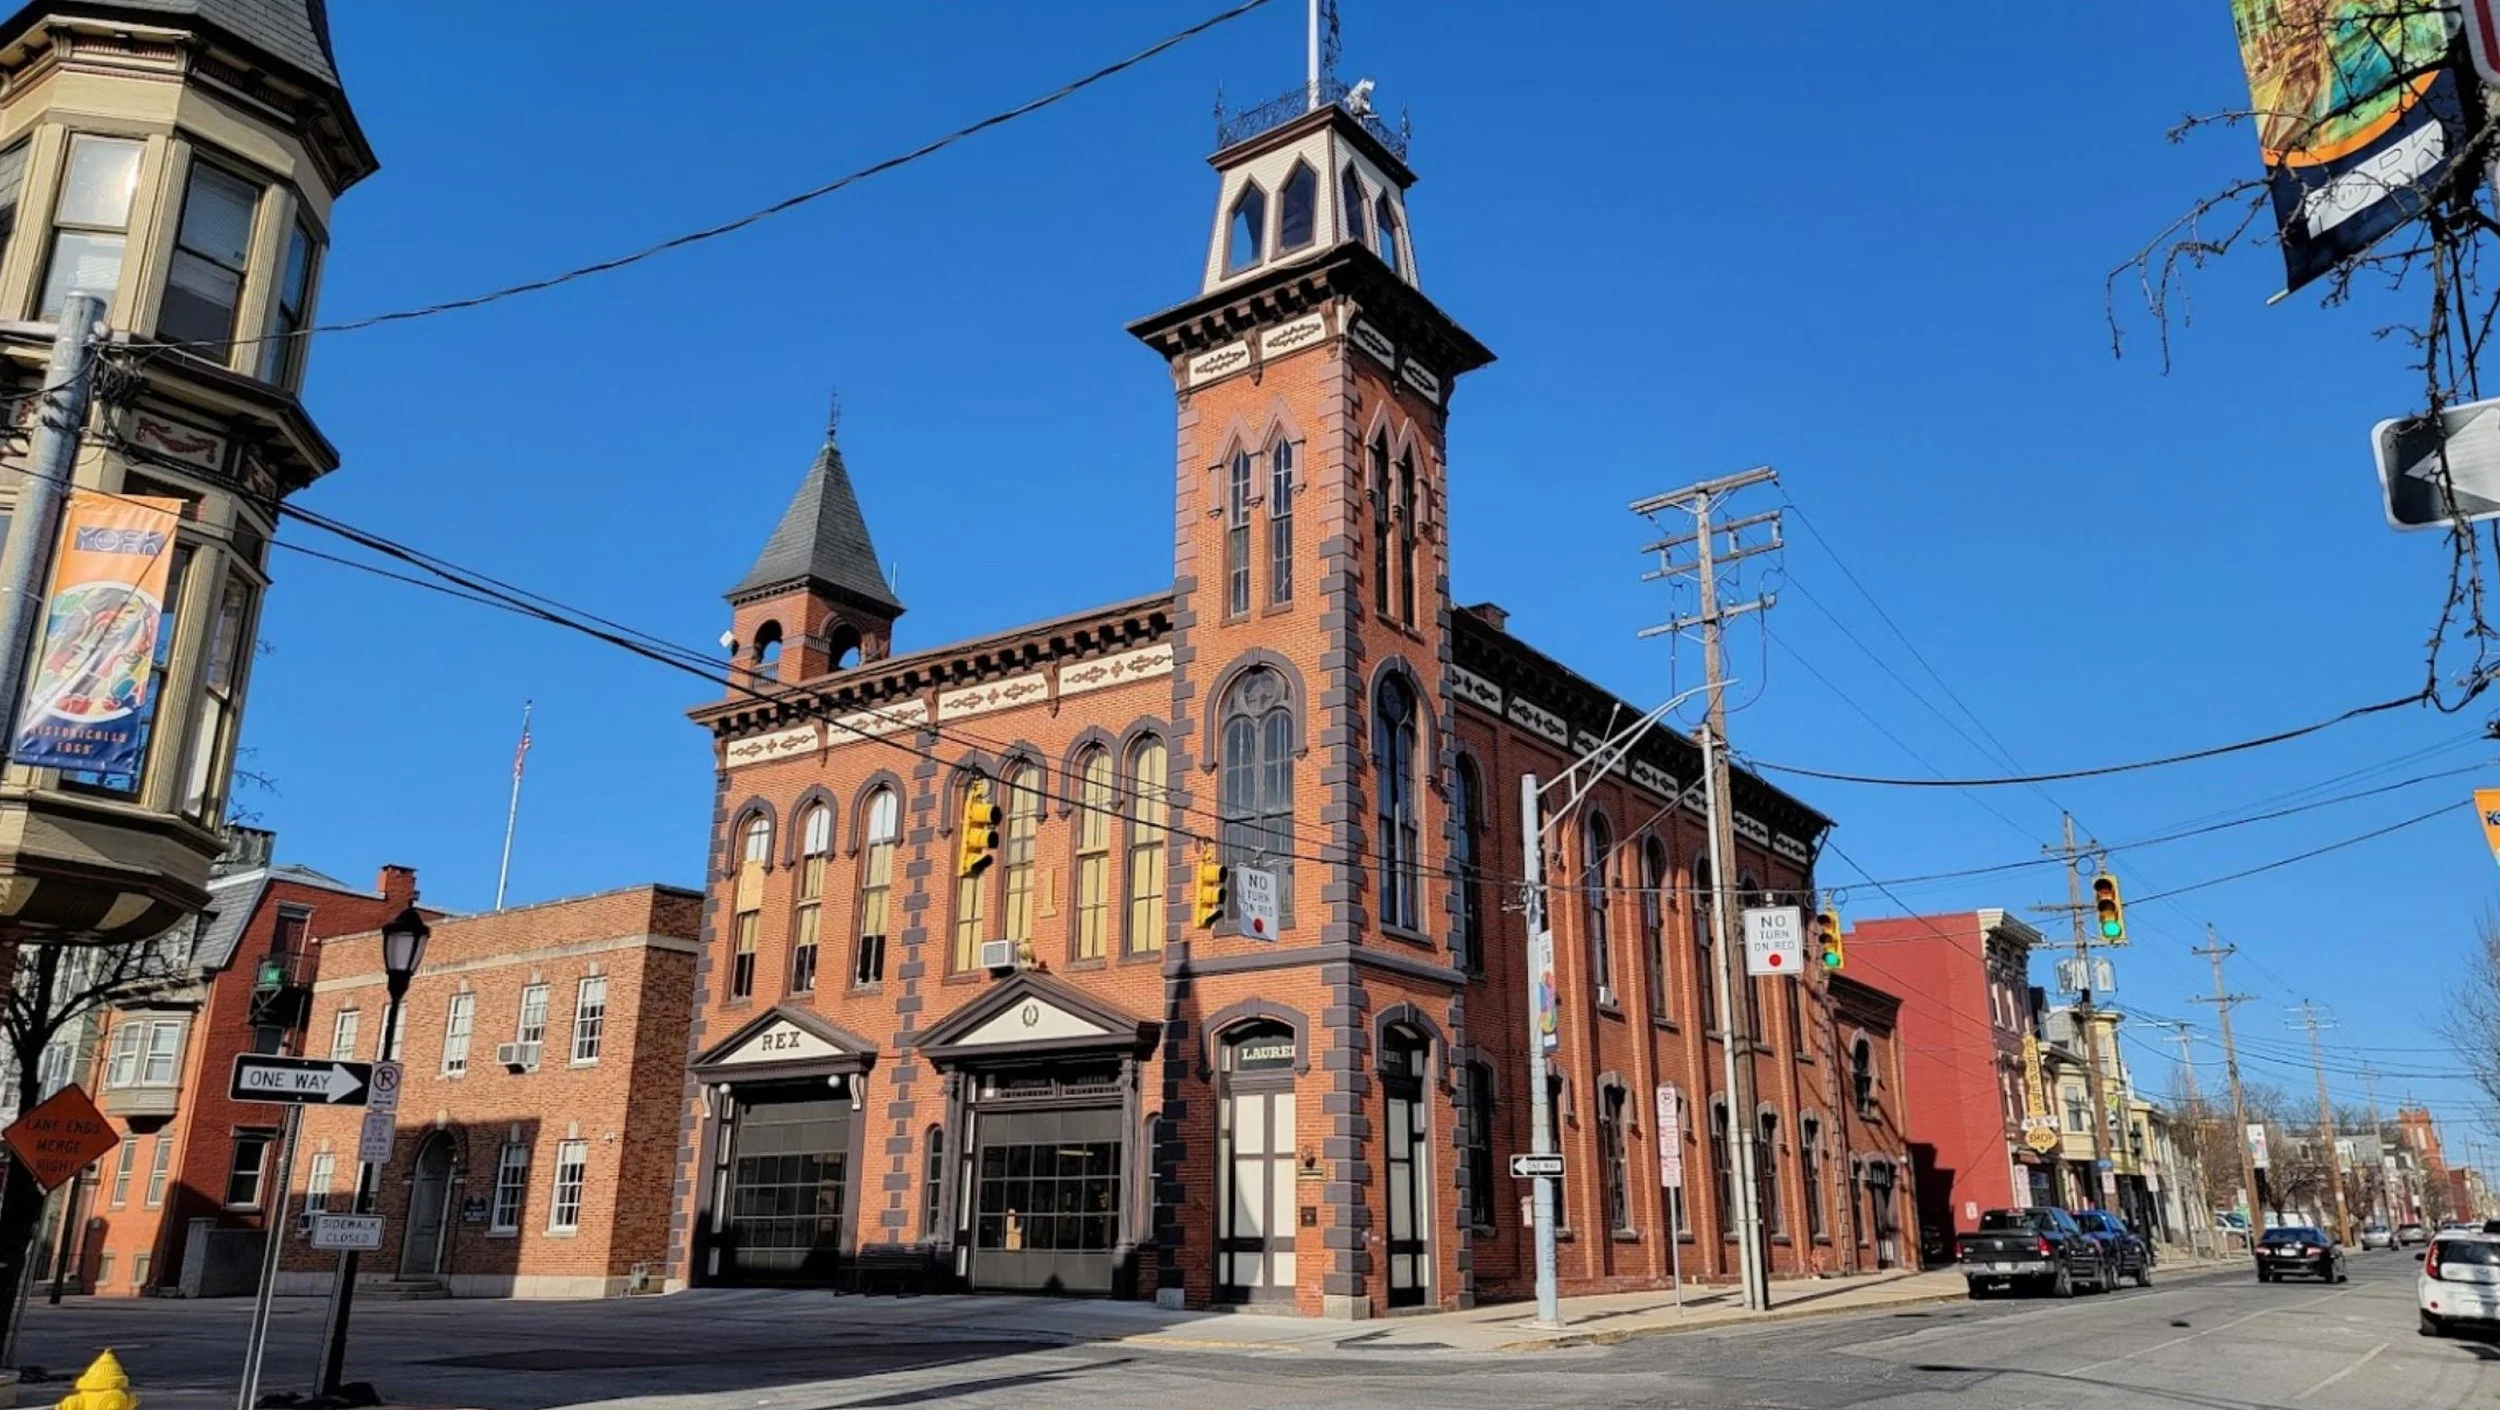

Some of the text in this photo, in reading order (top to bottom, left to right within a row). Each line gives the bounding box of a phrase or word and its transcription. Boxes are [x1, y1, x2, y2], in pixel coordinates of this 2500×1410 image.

[1249, 873, 1268, 890] NO
[1247, 890, 1269, 902] TURN
[1243, 902, 1254, 912] ON
[1761, 915, 1786, 928] NO
[1760, 930, 1789, 940] TURN
[1754, 942, 1795, 951] ON RED
[762, 1031, 800, 1051] REX
[250, 1070, 332, 1091] ONE WAY
[25, 1118, 101, 1134] LANE ENDS
[36, 1138, 82, 1154] MERGE
[36, 1158, 76, 1173] RIGHT
[322, 1219, 377, 1230] SIDEWALK
[326, 1232, 370, 1243] CLOSED
